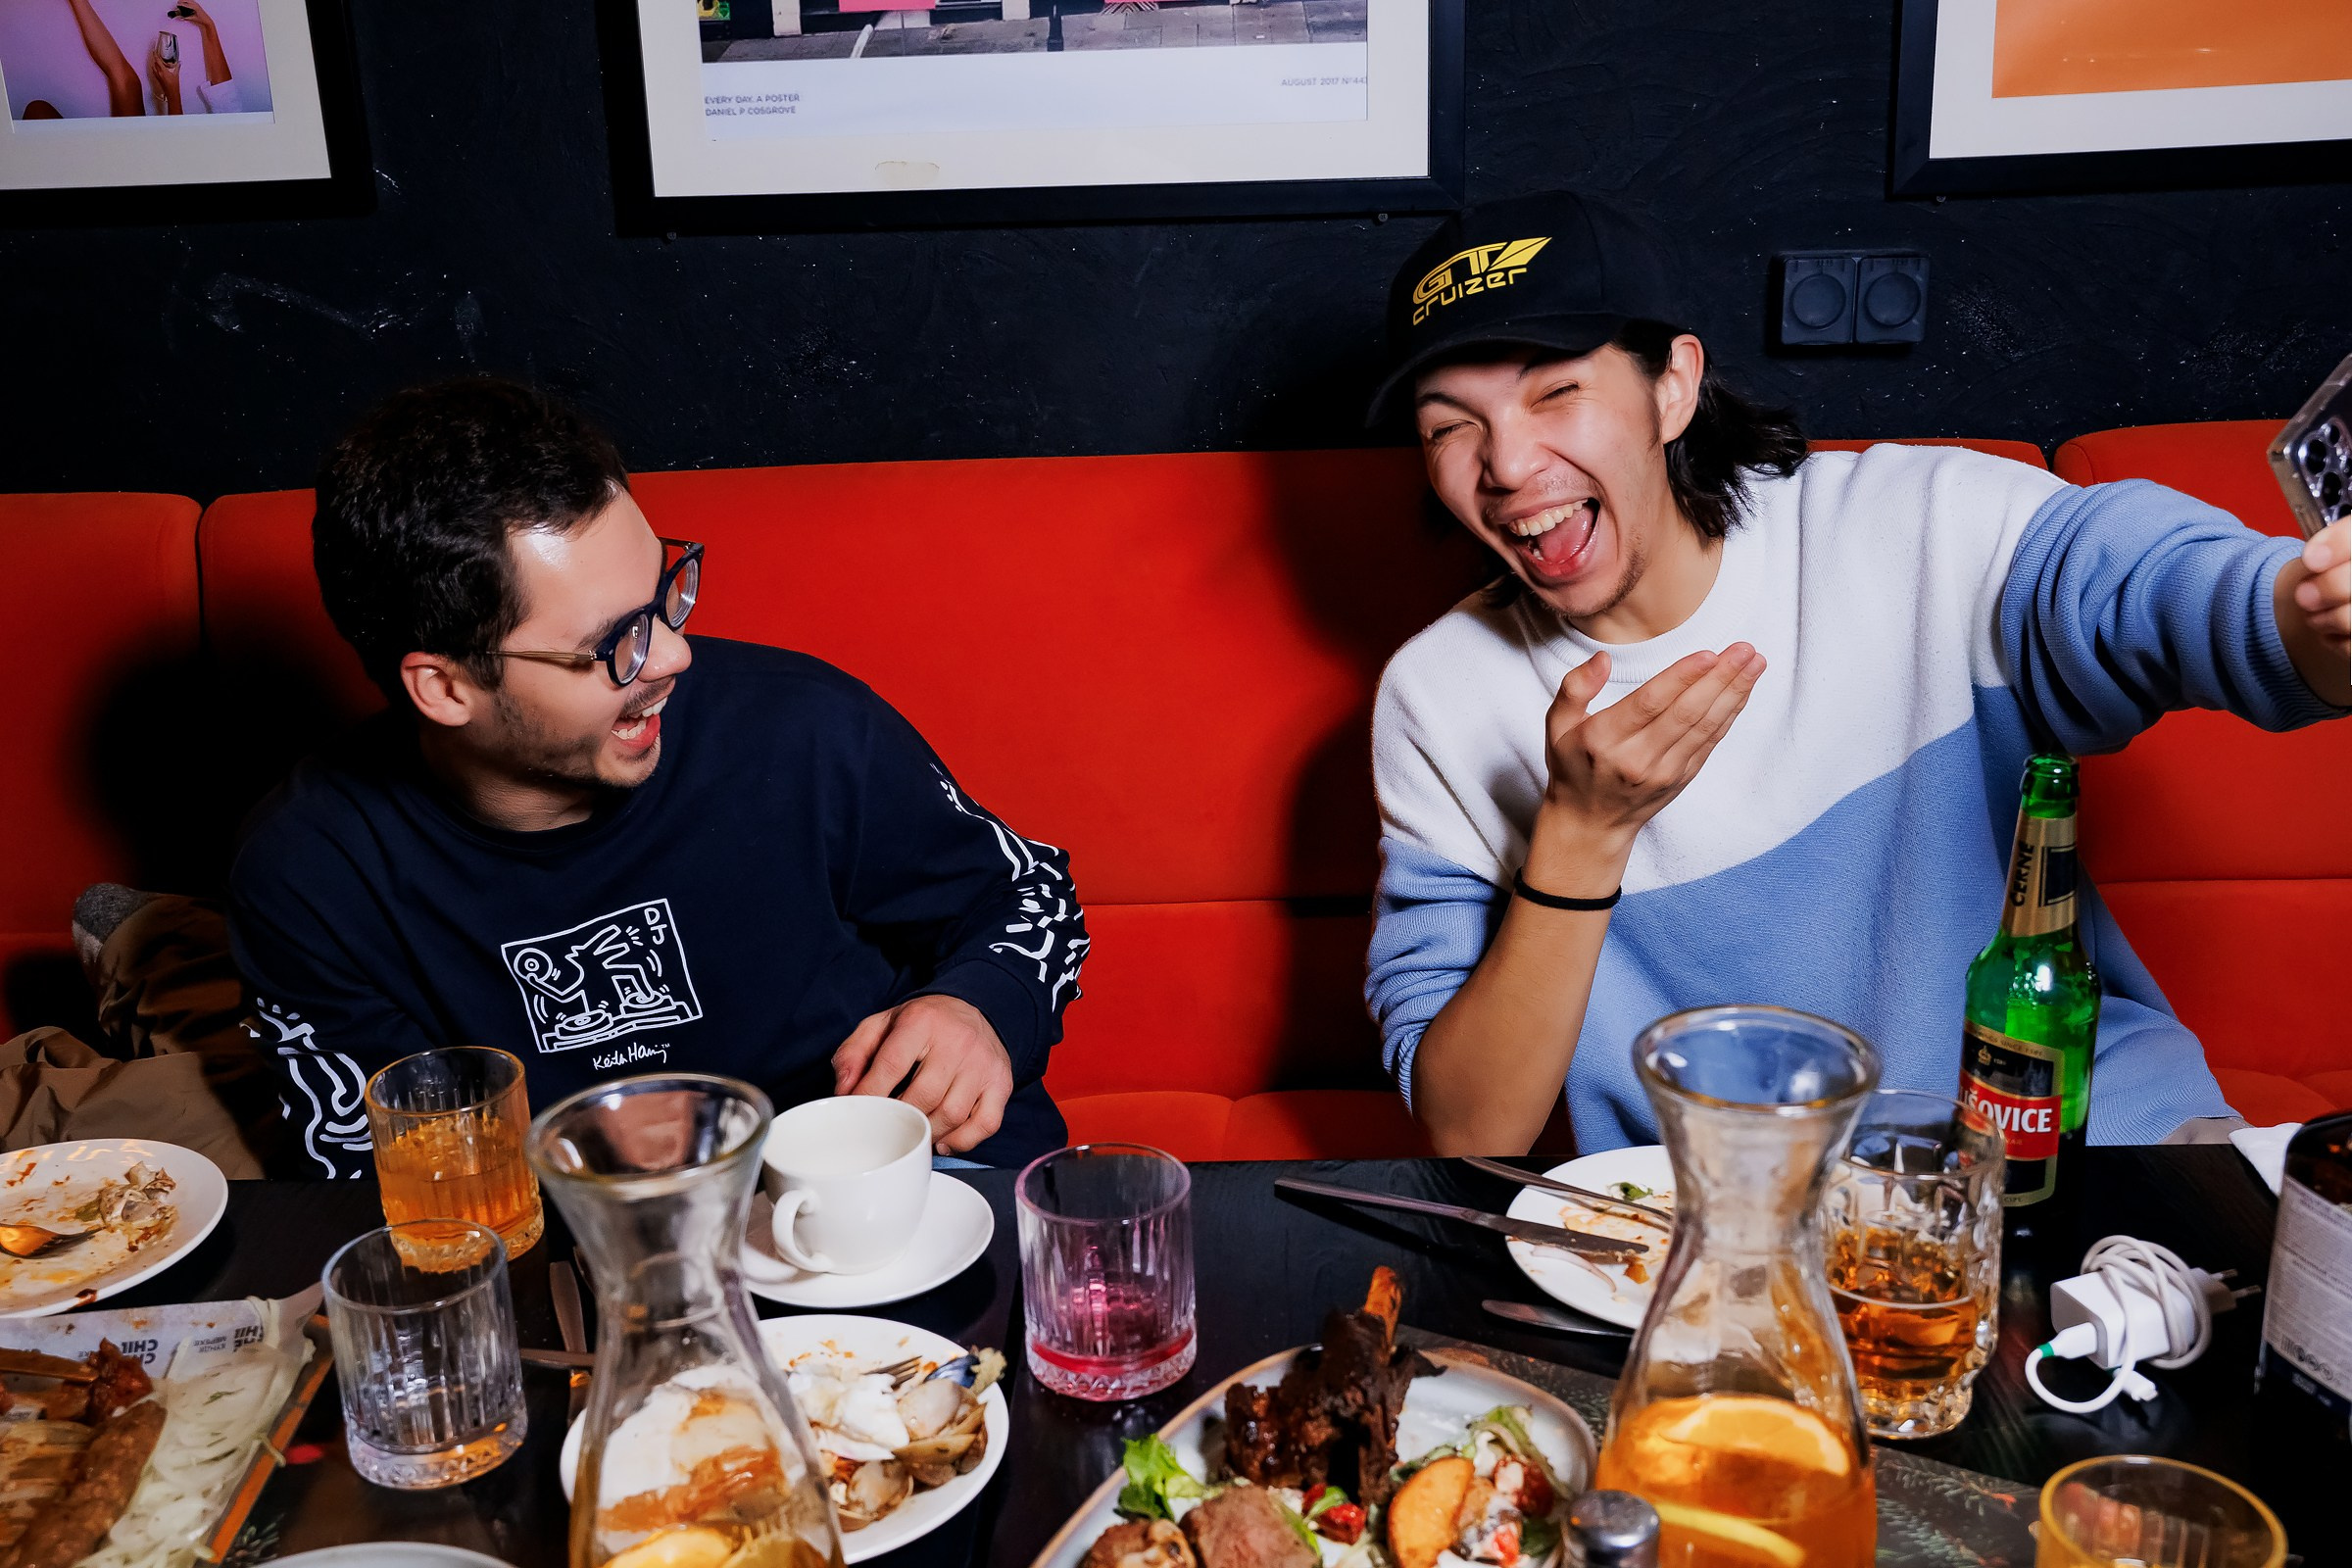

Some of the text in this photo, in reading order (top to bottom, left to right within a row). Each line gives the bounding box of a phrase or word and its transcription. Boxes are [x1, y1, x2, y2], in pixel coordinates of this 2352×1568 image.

[705, 95, 733, 104] EVERY
[757, 94, 763, 103] A
[765, 93, 800, 103] POSTER
[706, 107, 737, 117] DANIEL
[748, 105, 796, 116] COSGROVE
